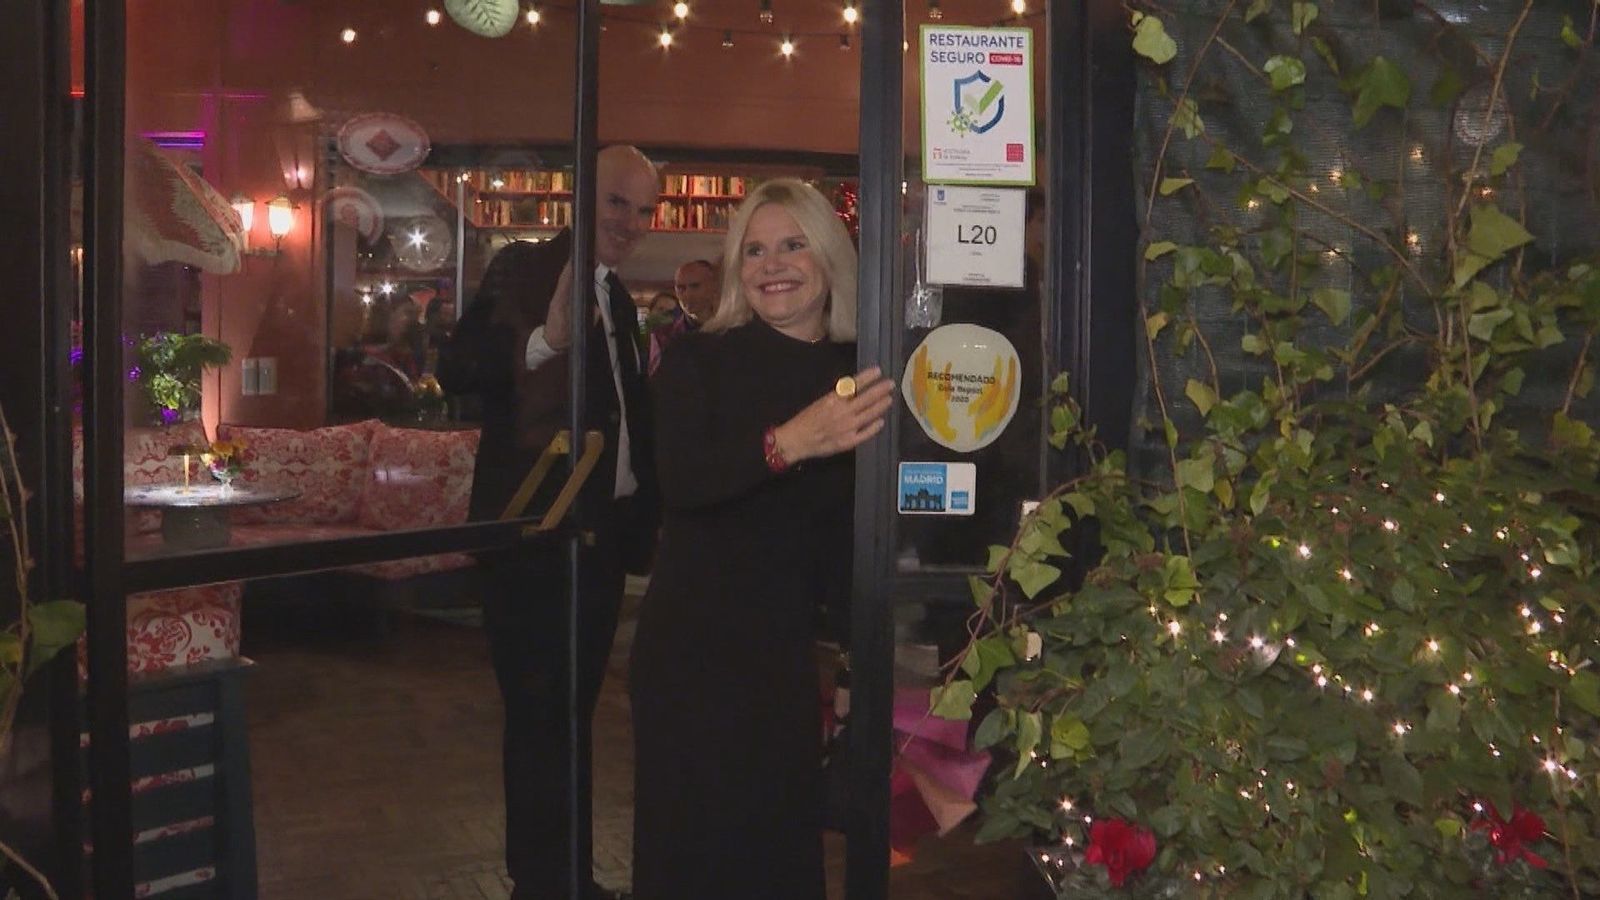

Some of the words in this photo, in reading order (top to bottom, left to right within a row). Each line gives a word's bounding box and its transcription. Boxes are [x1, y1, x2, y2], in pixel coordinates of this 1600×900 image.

[930, 33, 1024, 48] RESTAURANTE
[930, 51, 986, 65] SEGURO
[957, 224, 997, 245] L20
[928, 372, 995, 384] RECOMENDADO
[904, 474, 944, 485] MADRID
